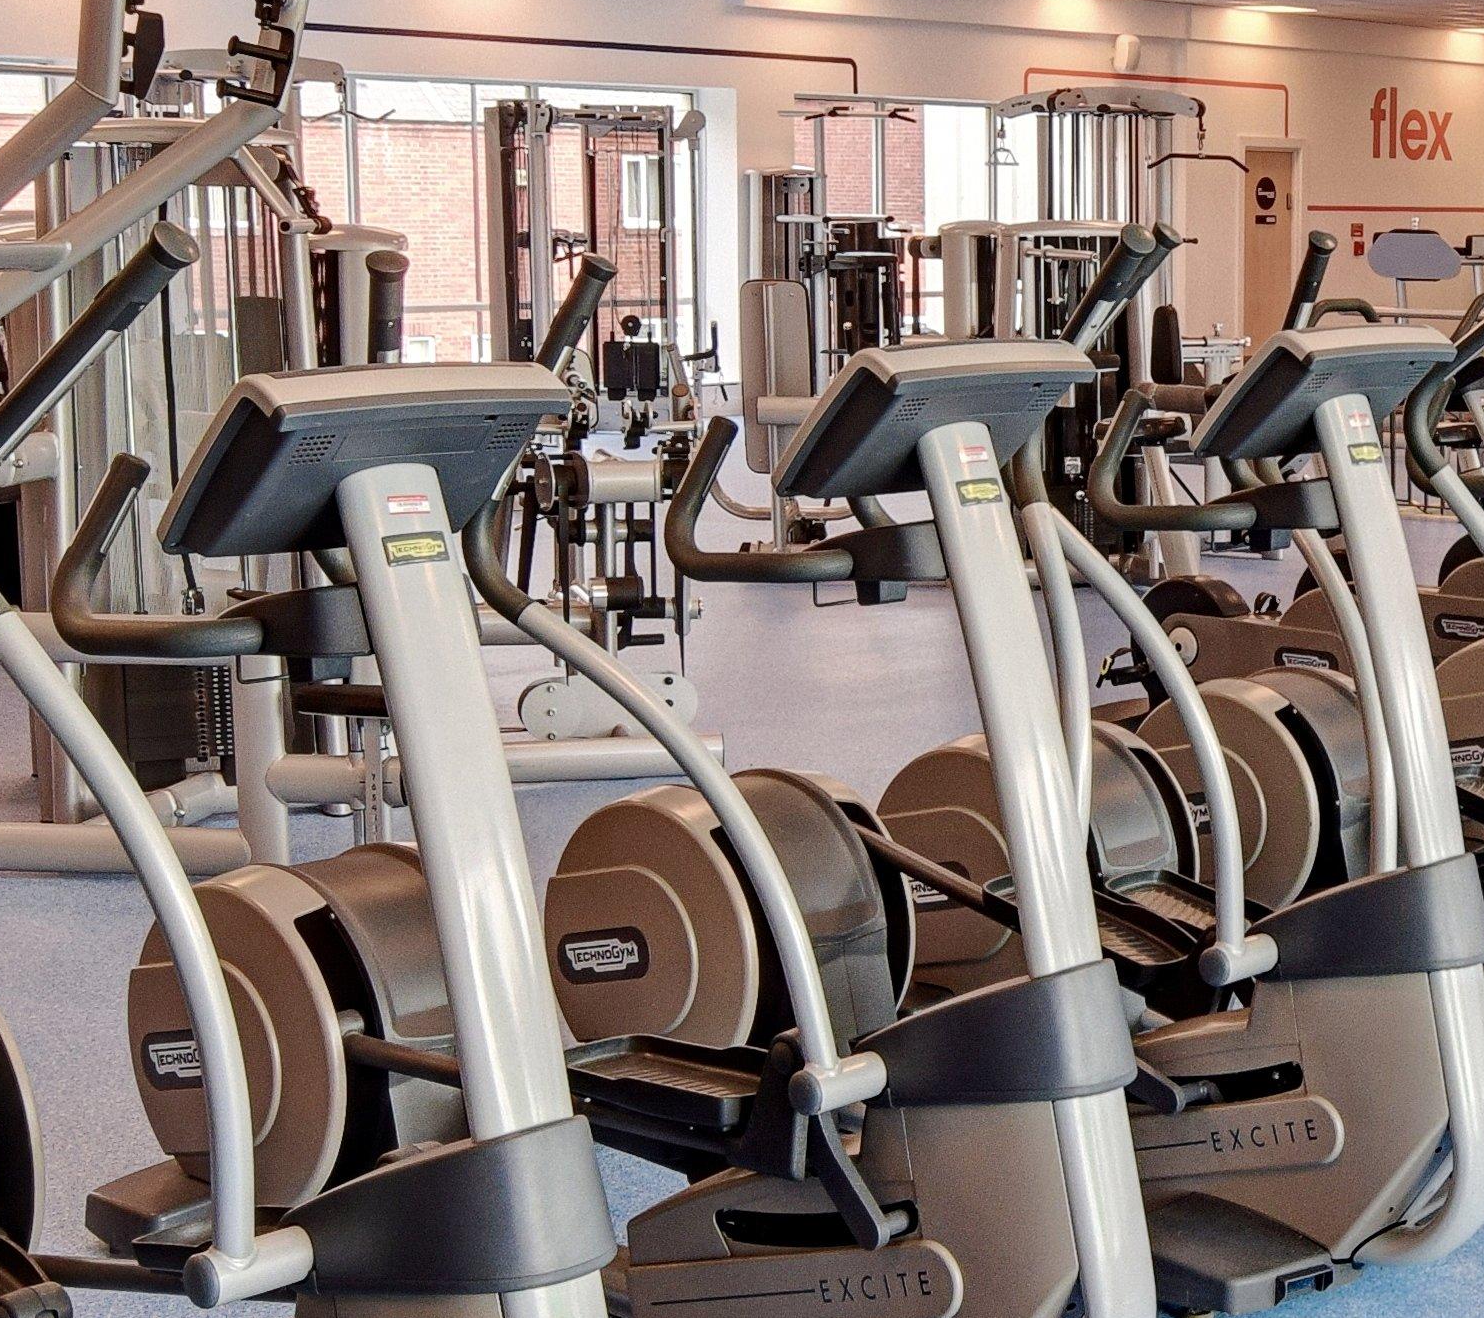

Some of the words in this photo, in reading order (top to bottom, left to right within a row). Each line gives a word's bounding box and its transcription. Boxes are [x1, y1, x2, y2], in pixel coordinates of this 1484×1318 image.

[1370, 87, 1453, 161] flex
[568, 944, 635, 966] TECHNOGYM
[151, 1046, 201, 1070] TECHNO
[1210, 1119, 1318, 1152] EXCITE
[818, 1271, 932, 1303] EXCITE
